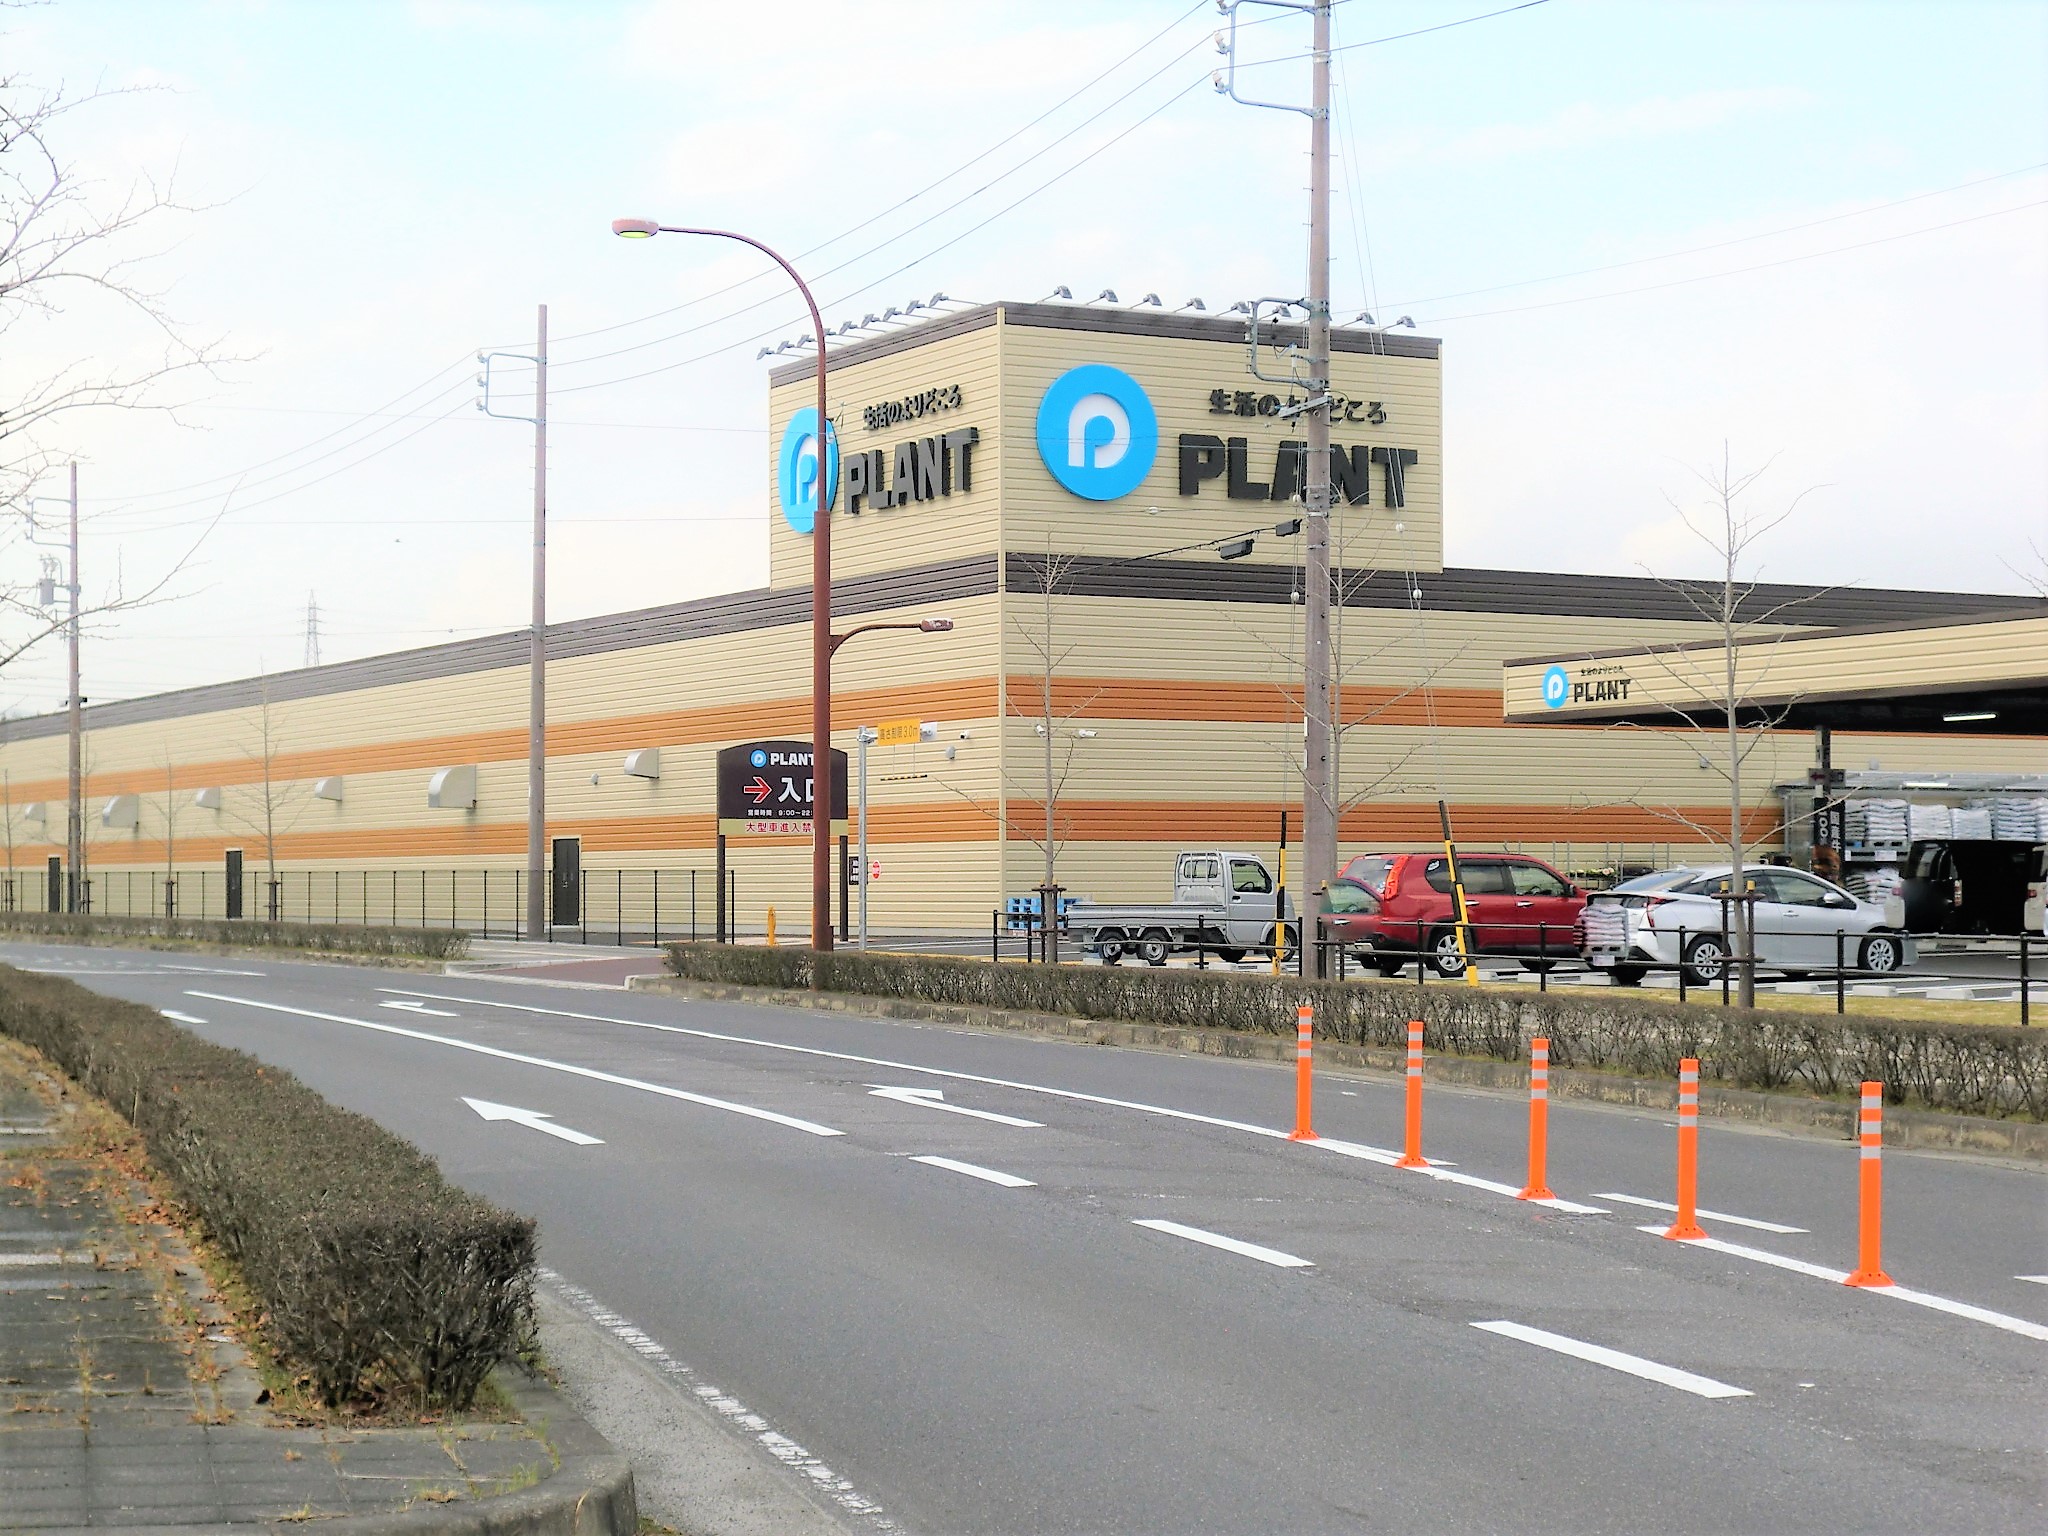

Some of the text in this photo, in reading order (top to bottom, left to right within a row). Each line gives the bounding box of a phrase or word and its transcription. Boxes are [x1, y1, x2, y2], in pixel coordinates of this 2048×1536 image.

[863, 384, 963, 430] 生活のよりどころ
[1209, 388, 1387, 424] 生活のどころ
[843, 426, 980, 515] PLANT
[1178, 433, 1418, 508] PLANT
[1574, 679, 1631, 703] PLANT
[746, 822, 812, 833] 大型車進入禁
